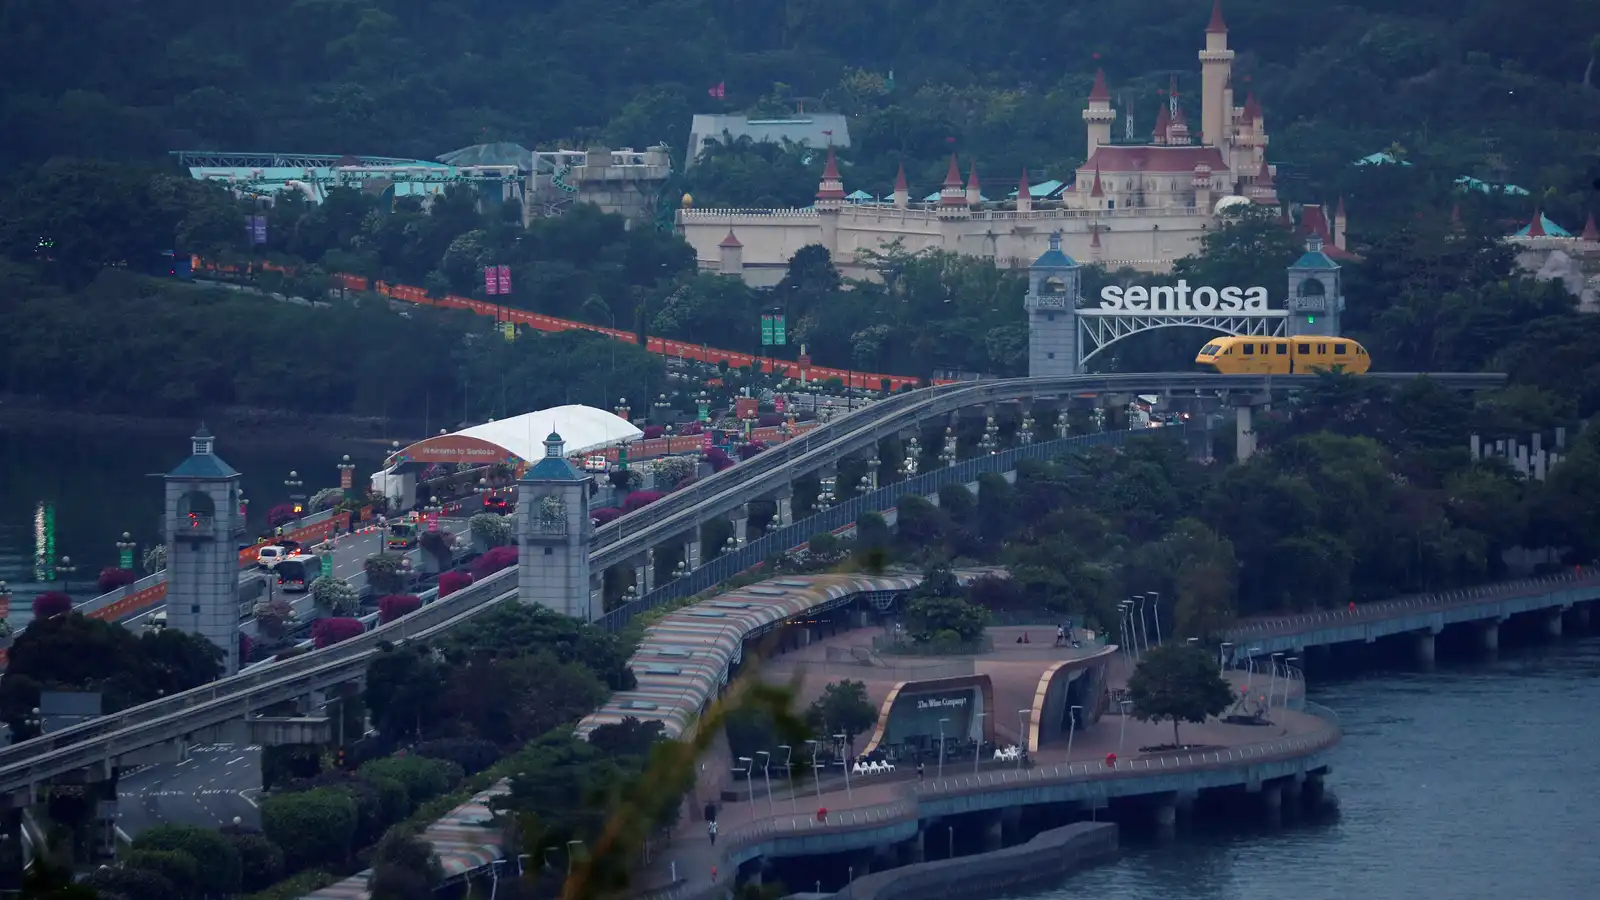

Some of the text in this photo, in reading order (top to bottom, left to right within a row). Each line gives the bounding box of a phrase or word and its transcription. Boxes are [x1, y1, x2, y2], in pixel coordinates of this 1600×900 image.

[1100, 279, 1268, 311] sentosa
[423, 447, 456, 455] Welcome
[457, 447, 464, 455] to
[917, 700, 928, 708] The
